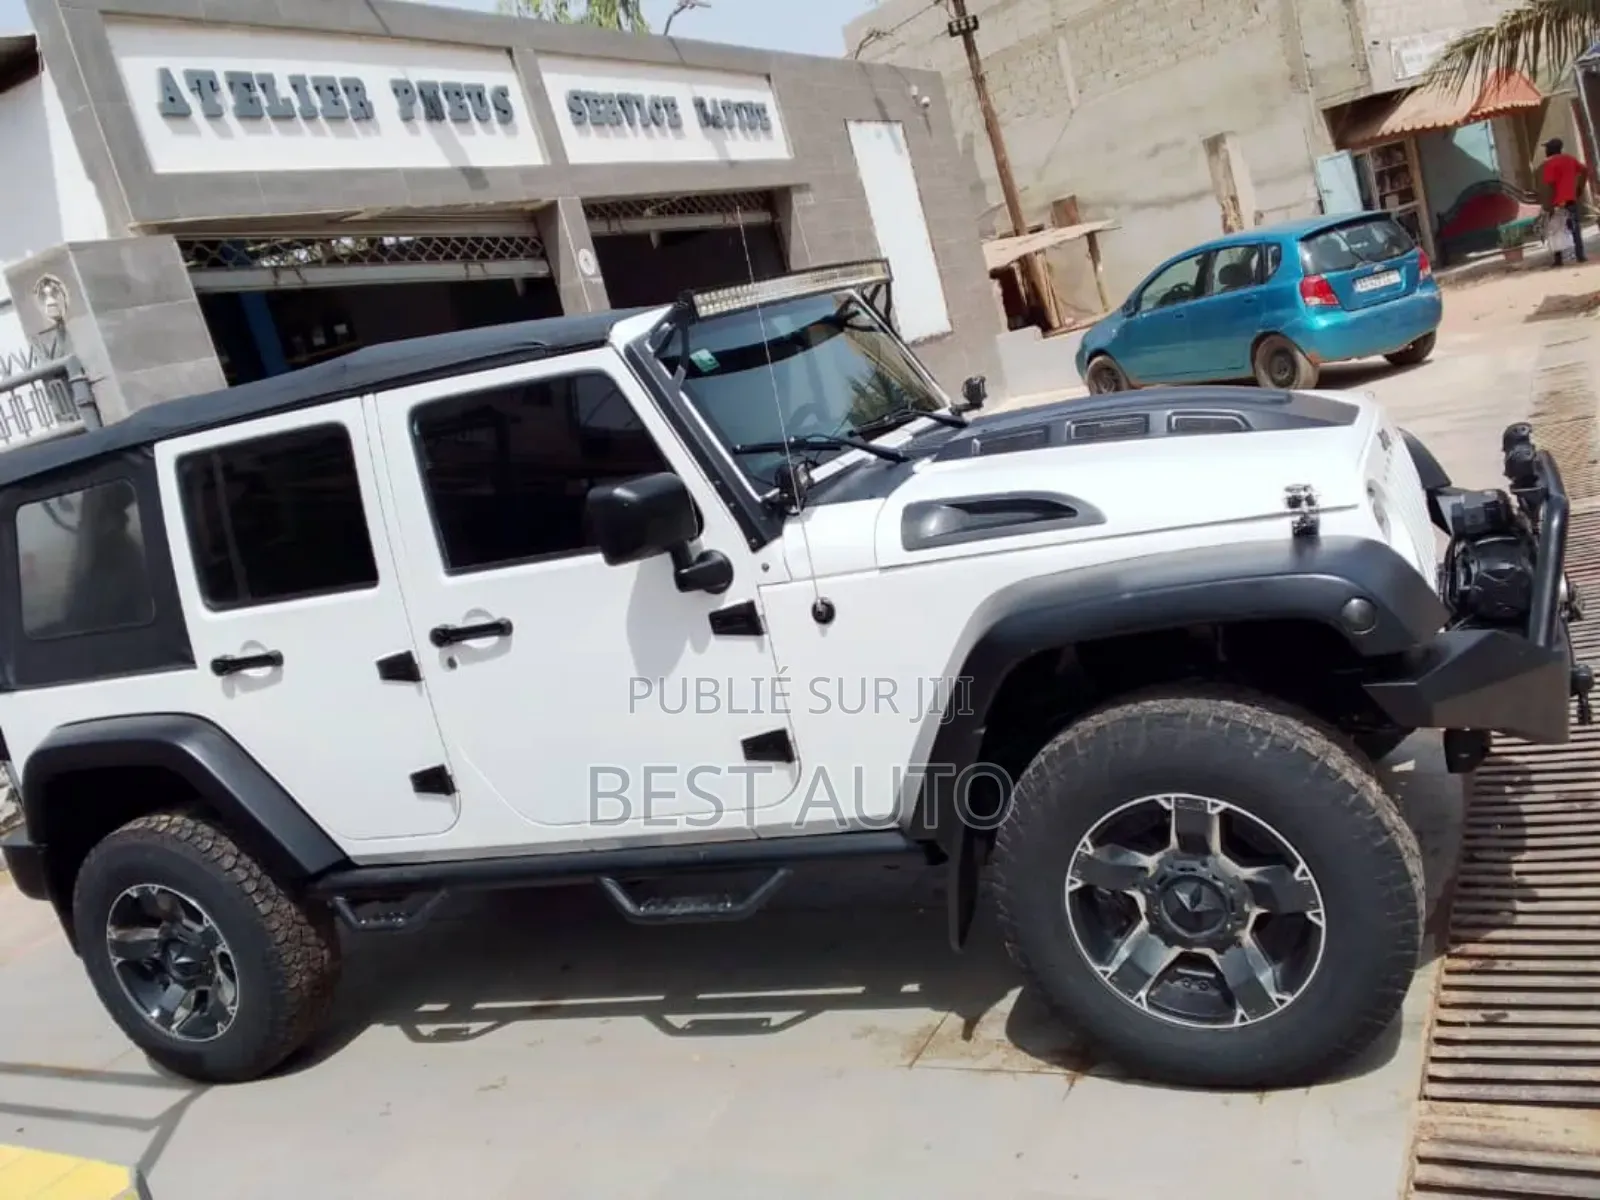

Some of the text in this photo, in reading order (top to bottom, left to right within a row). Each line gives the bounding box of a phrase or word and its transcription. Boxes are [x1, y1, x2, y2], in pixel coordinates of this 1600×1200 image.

[156, 67, 514, 124] ATELIER PNEUS
[567, 90, 683, 129] SERVICE
